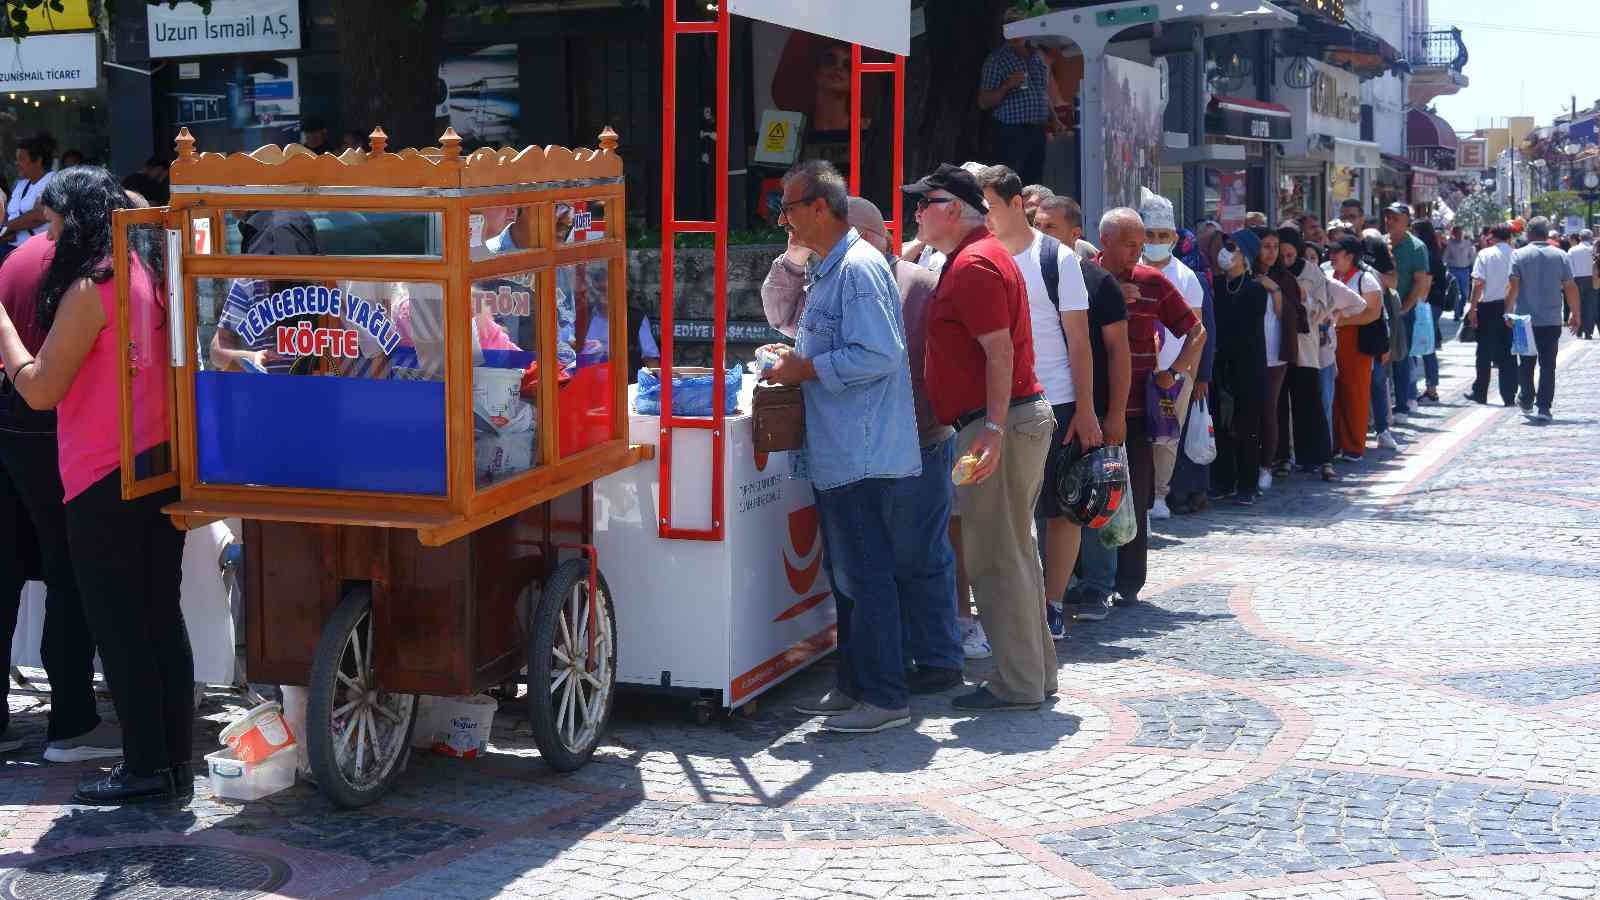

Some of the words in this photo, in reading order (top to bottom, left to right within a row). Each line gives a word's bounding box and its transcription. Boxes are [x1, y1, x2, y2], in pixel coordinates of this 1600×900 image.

[155, 22, 198, 42] Uzun
[205, 16, 255, 39] İsmail
[262, 14, 294, 39] A.Ş.
[237, 286, 341, 346] TENCEREDE
[346, 294, 400, 355] YAĞLI
[277, 321, 359, 358] KÖFTE
